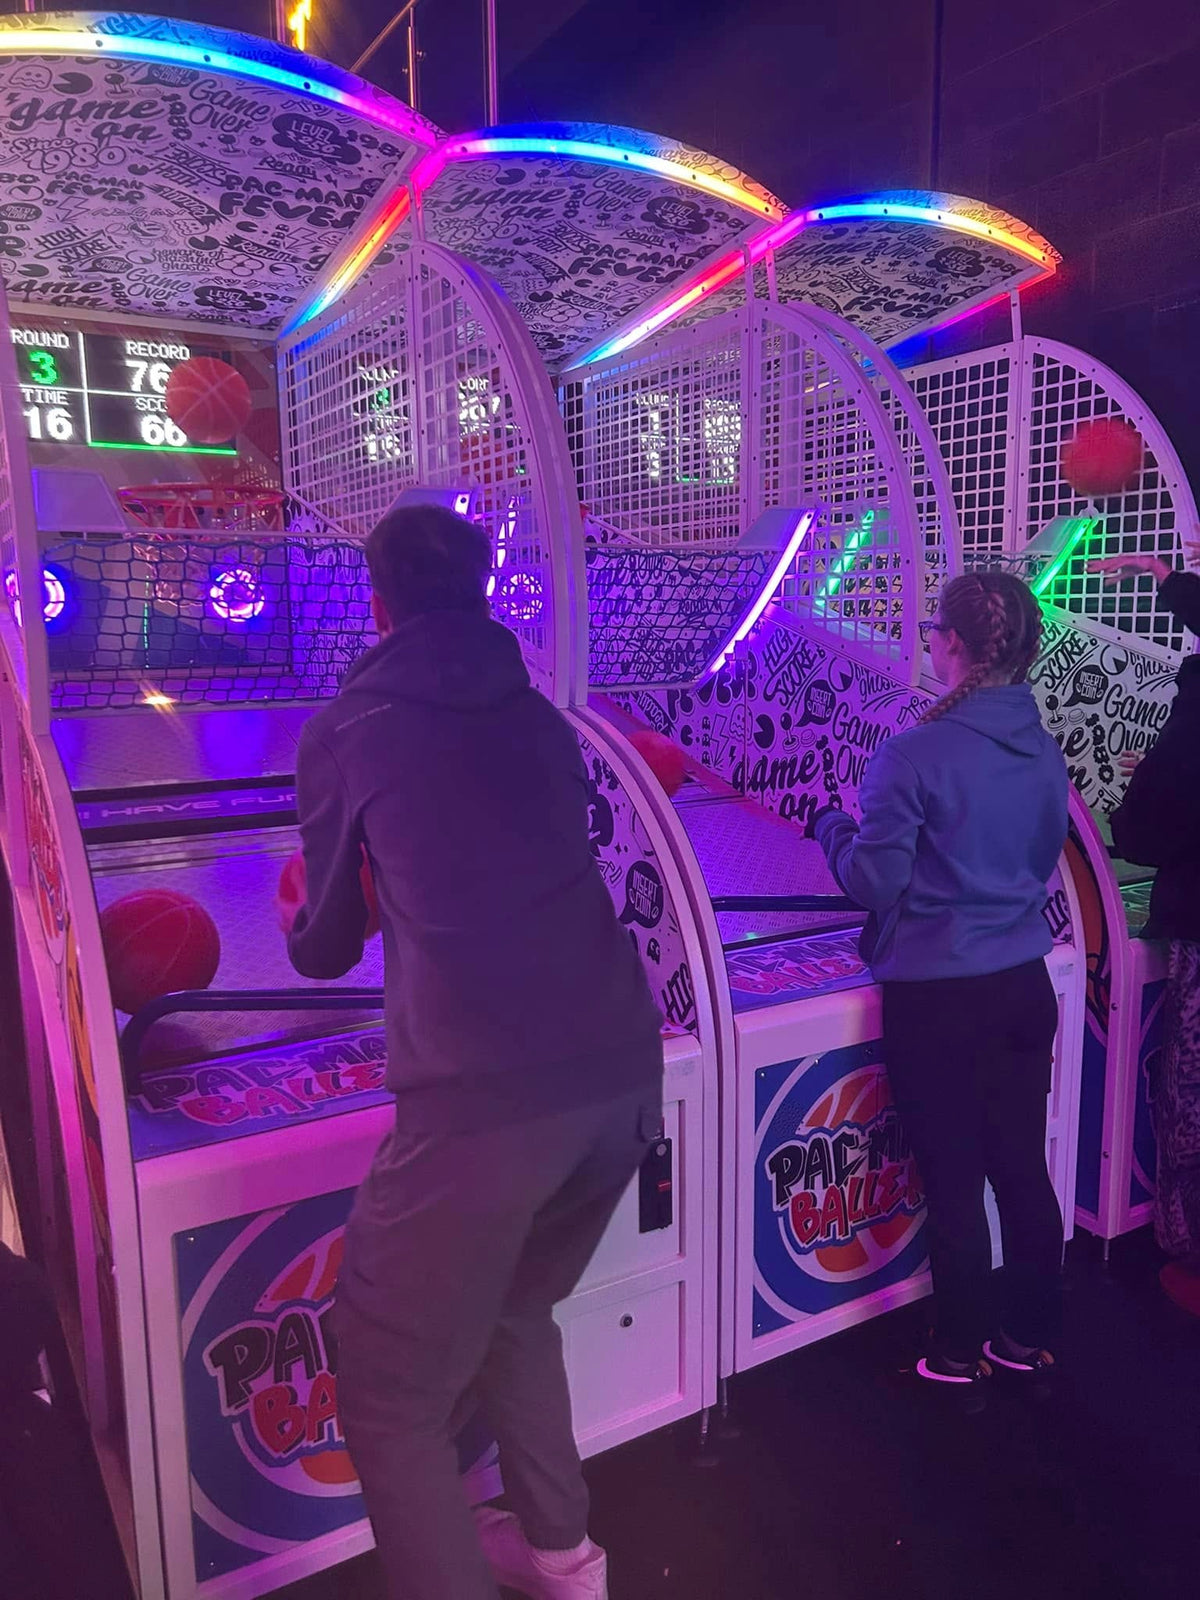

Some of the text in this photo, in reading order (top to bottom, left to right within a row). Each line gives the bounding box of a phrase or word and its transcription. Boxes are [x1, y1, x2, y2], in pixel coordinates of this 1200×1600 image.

[189, 79, 271, 122] Game
[5, 97, 166, 135] game
[189, 103, 254, 133] Over
[10, 137, 78, 152] Since
[90, 122, 164, 148] on
[292, 120, 334, 144] LEVEL
[300, 136, 342, 154] 256
[22, 142, 127, 175] 1980
[46, 180, 146, 204] FEVER
[55, 171, 145, 190] PAC-MAN
[225, 174, 365, 210] PAC-MAN
[592, 172, 653, 204] Game
[442, 188, 568, 215] game
[582, 190, 632, 212] Over
[660, 200, 694, 219] LEVEL
[35, 226, 88, 250] HIGH
[439, 221, 520, 246] 1980
[898, 225, 945, 252] Game
[581, 243, 695, 269] PAC-MAN
[127, 268, 191, 293] Game
[128, 283, 178, 300] Over
[10, 328, 70, 348] ROUND
[125, 341, 190, 361] RECORD
[29, 351, 59, 385] 3
[22, 388, 69, 406] TIME
[136, 398, 168, 412] SCO
[23, 406, 75, 441] 16
[1104, 683, 1169, 731] Game
[101, 800, 221, 818] HAVE
[179, 1063, 387, 1126] BALLE
